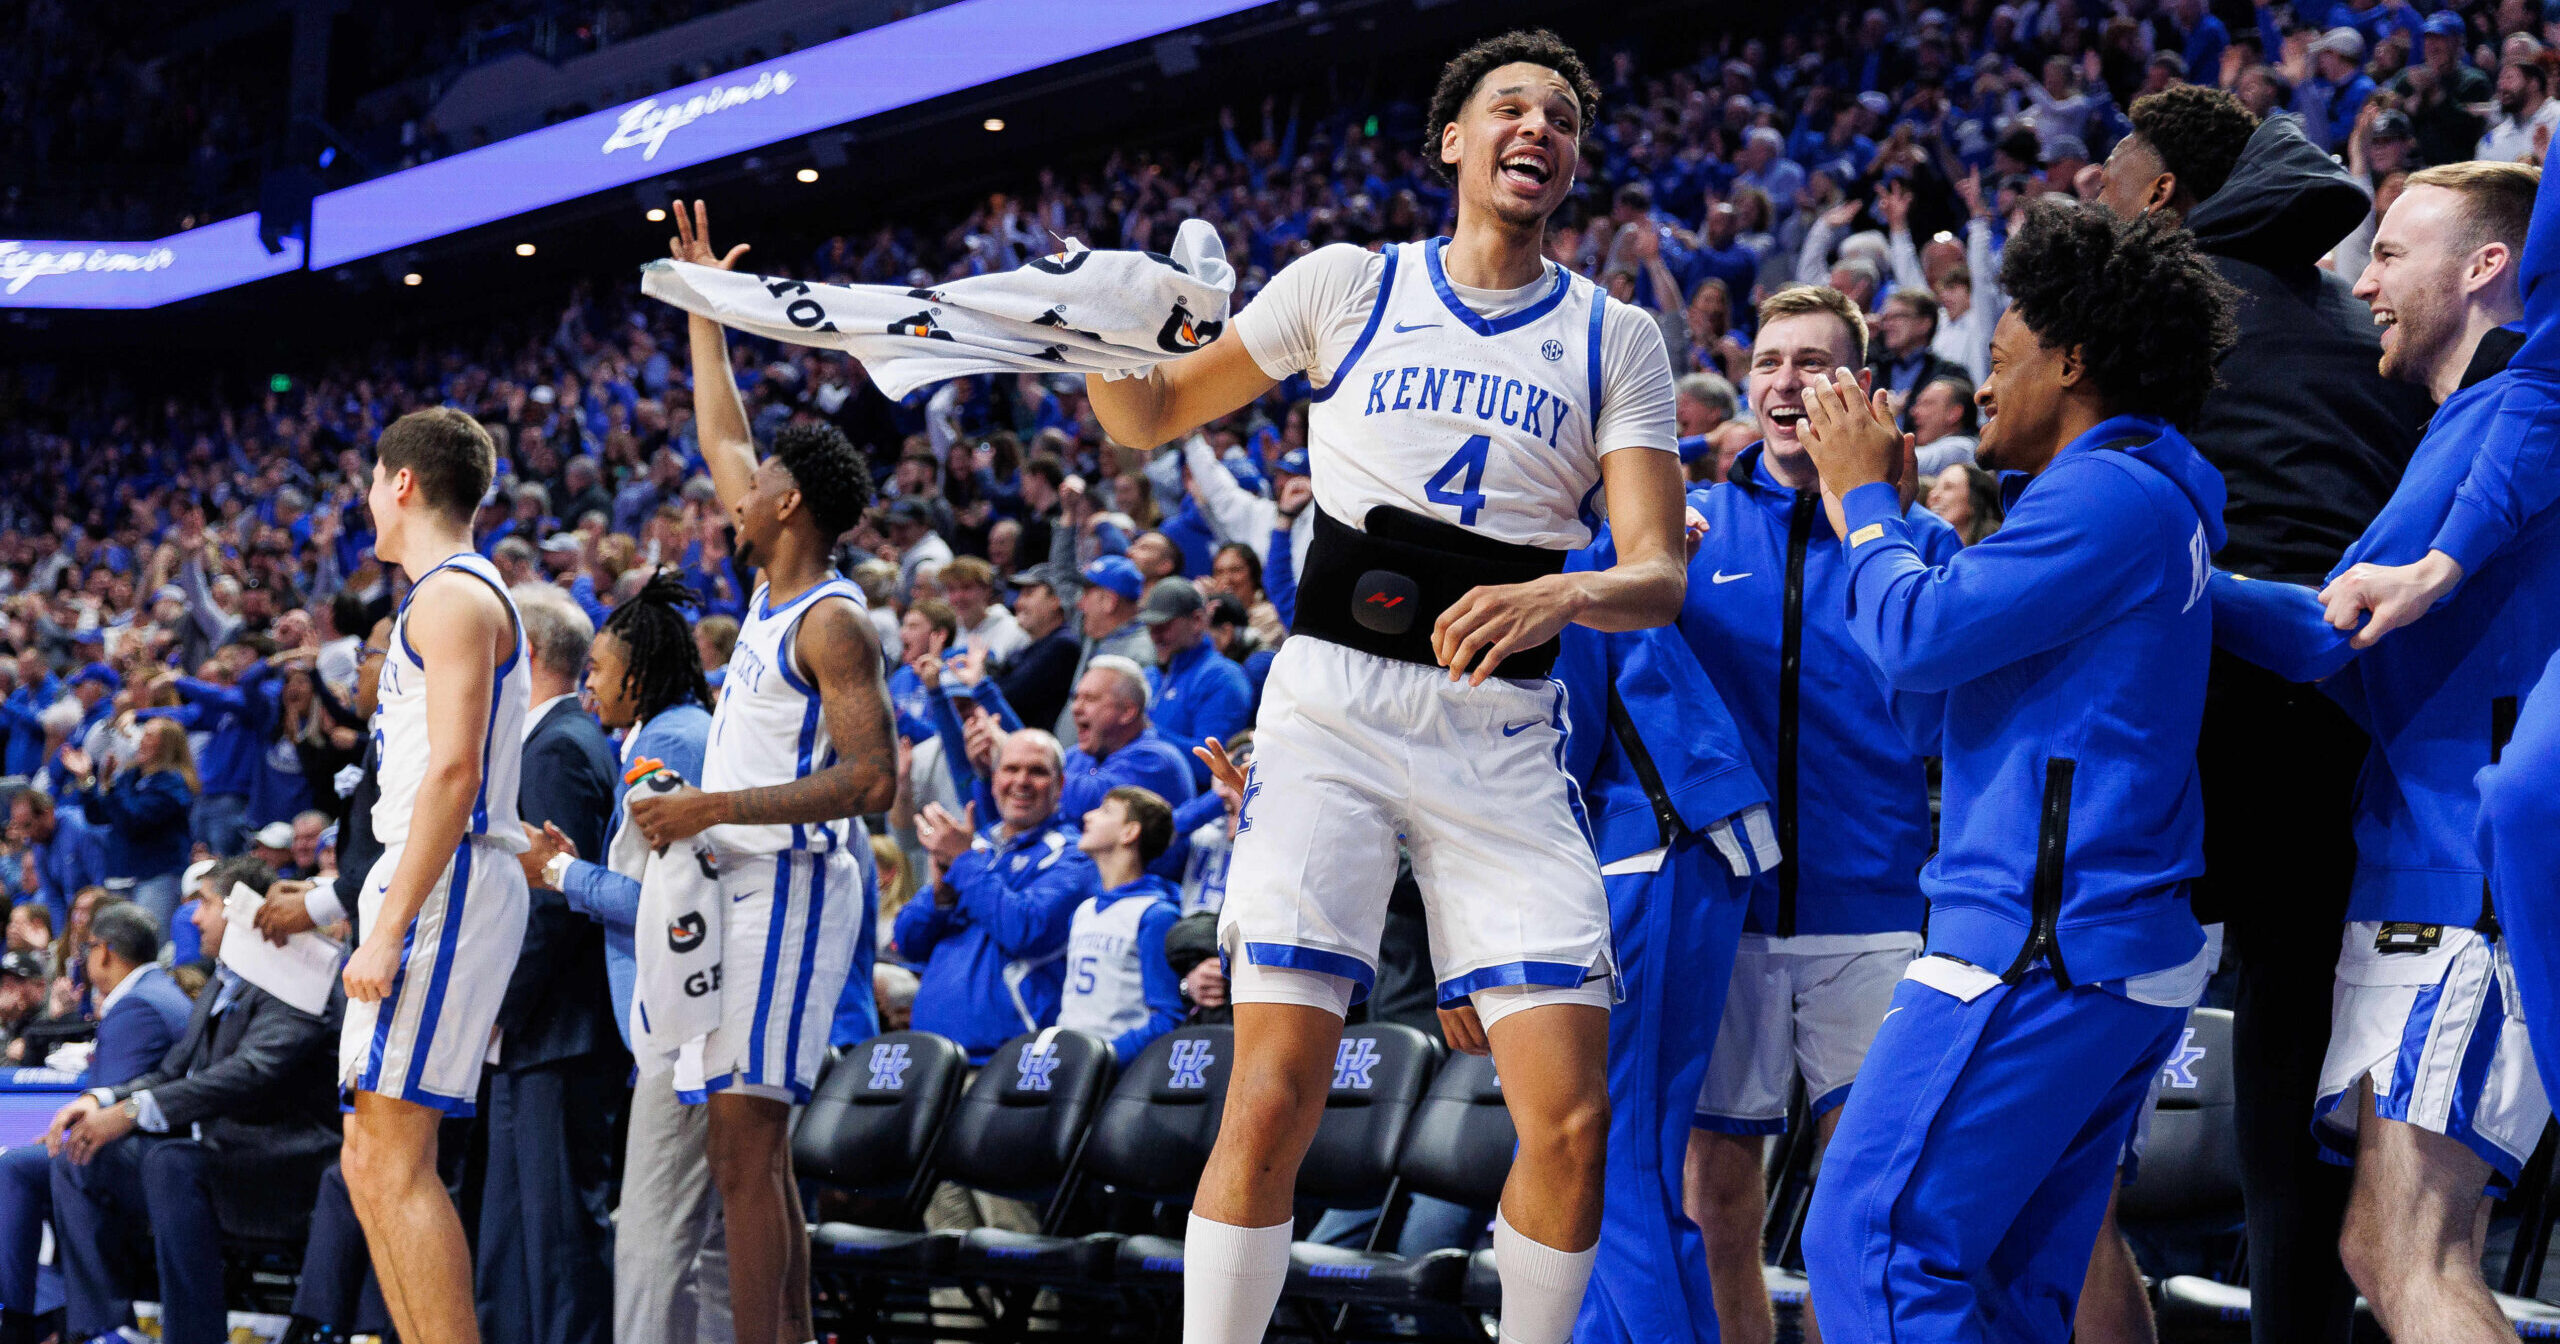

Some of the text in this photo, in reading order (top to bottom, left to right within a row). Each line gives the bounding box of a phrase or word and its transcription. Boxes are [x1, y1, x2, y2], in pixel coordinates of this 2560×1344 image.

[1541, 339, 1564, 361] SEC
[1364, 366, 1569, 449] KENTUCKY
[1424, 434, 1491, 527] 4
[2422, 926, 2437, 939] 48
